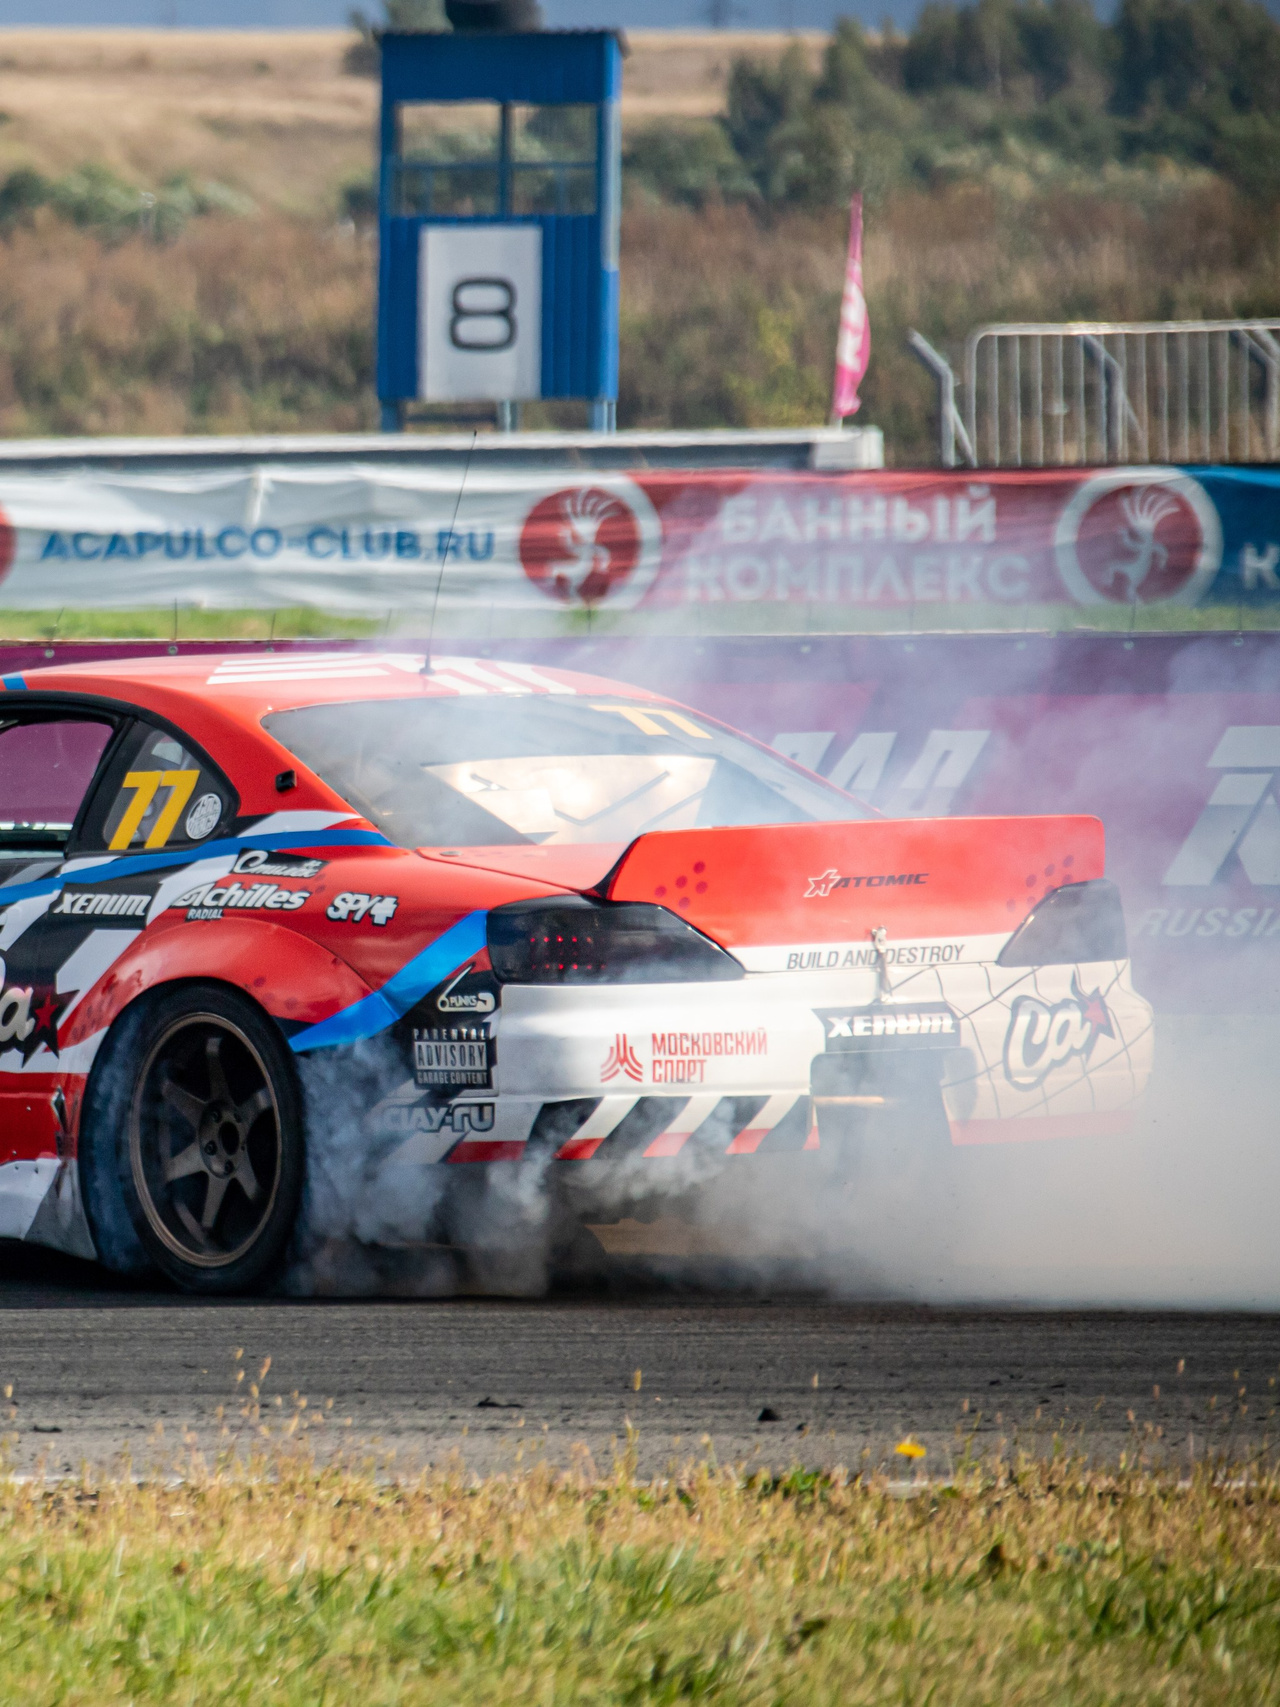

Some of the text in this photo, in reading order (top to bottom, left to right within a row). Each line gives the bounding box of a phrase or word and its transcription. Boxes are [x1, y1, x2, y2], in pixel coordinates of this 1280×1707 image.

[449, 276, 517, 351] 8
[721, 484, 998, 543] БАННЫЙ
[40, 526, 496, 562] ACAPULCO-CLUB.RU
[685, 553, 1032, 602] КОМПЛЕКС
[108, 770, 200, 850] 77
[833, 873, 929, 888] ATOMIC
[54, 893, 151, 915] XENUM
[171, 882, 310, 909] Achilles
[187, 909, 223, 919] RADIAL
[787, 944, 965, 970] BUILD AND DESTROY
[414, 1028, 486, 1040] PARENTAL
[827, 1012, 956, 1038] XENUM
[652, 1027, 767, 1056] МОСКОВСКИЙ
[417, 1044, 486, 1067] ADVISORY
[450, 1071, 487, 1084] CONTENT
[652, 1059, 707, 1083] СПОРТ
